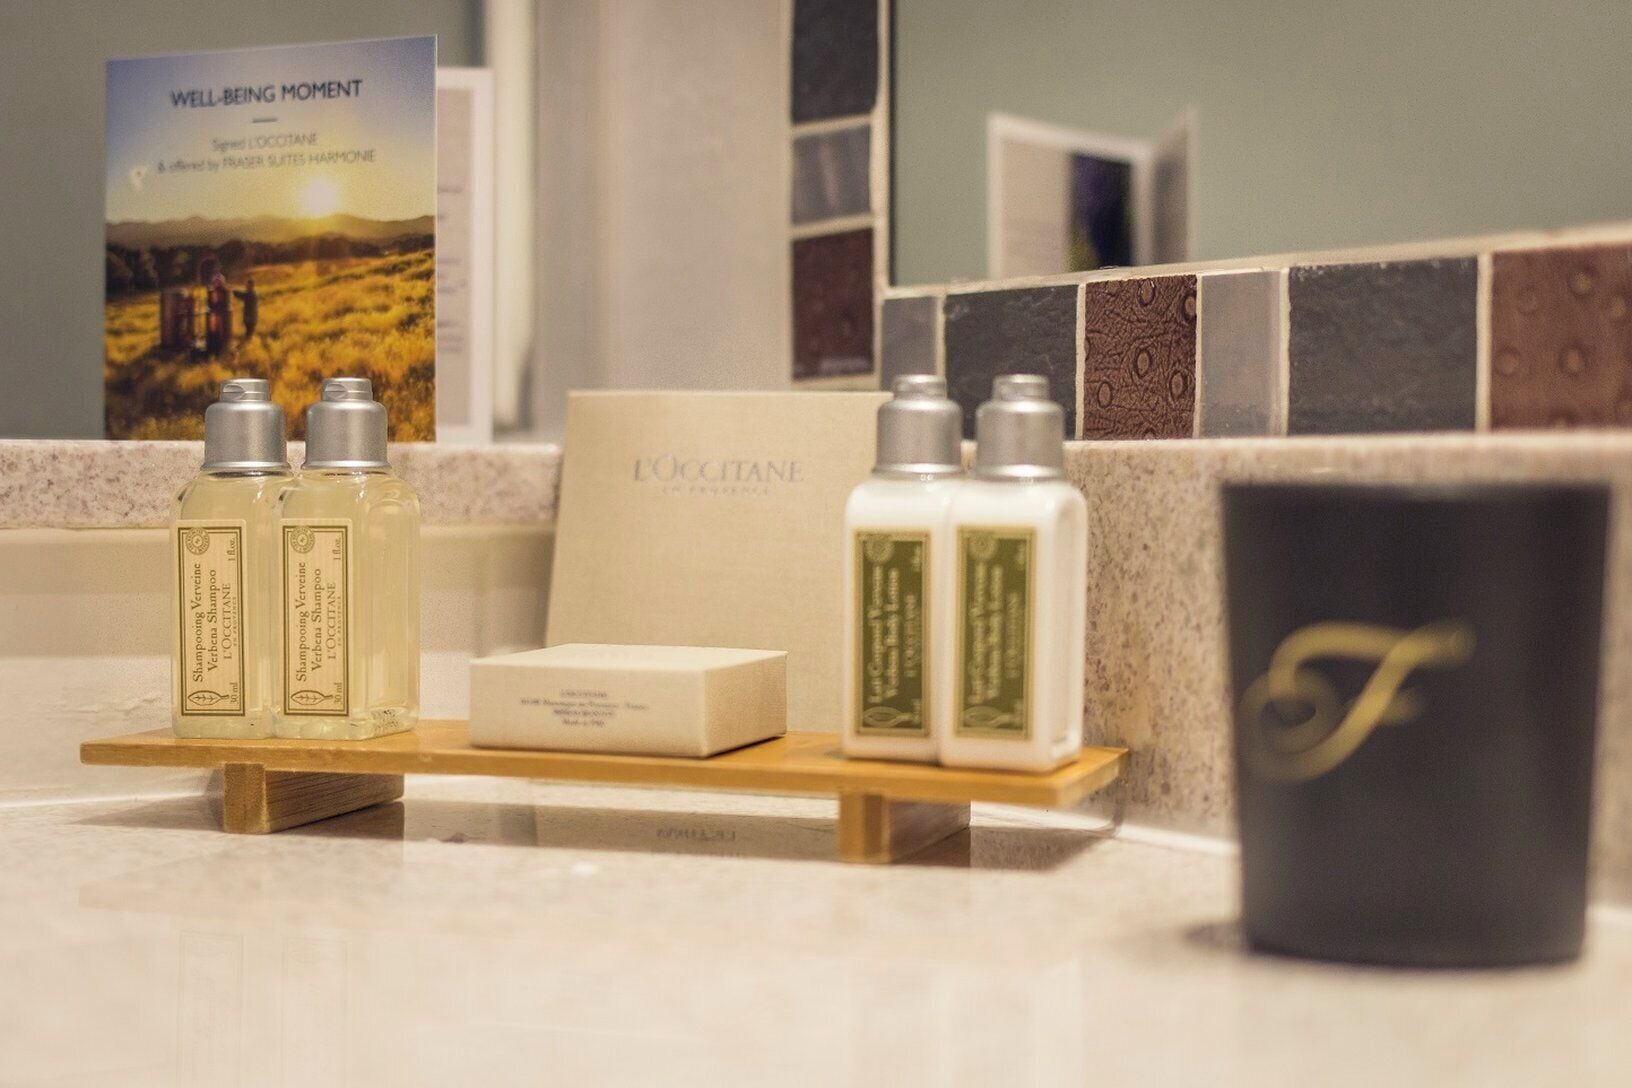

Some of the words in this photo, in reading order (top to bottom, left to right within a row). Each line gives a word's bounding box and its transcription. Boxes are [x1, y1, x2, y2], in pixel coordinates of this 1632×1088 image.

[170, 84, 276, 108] WELL-BEING
[281, 79, 363, 101] MOMENT
[309, 148, 375, 165] HARMONIE
[633, 453, 805, 483] L'OCCITANE
[191, 563, 202, 611] Verveine
[207, 569, 220, 624] Shampoo
[295, 561, 307, 610] Verveine
[311, 568, 325, 623] Shampoo
[221, 582, 233, 660] L'OCCITANE
[325, 582, 337, 660] L'OCCITANE
[192, 611, 205, 683] Shampooing
[207, 627, 218, 672] Verbena
[295, 611, 309, 682] Shampooing
[311, 627, 322, 671] Verbena
